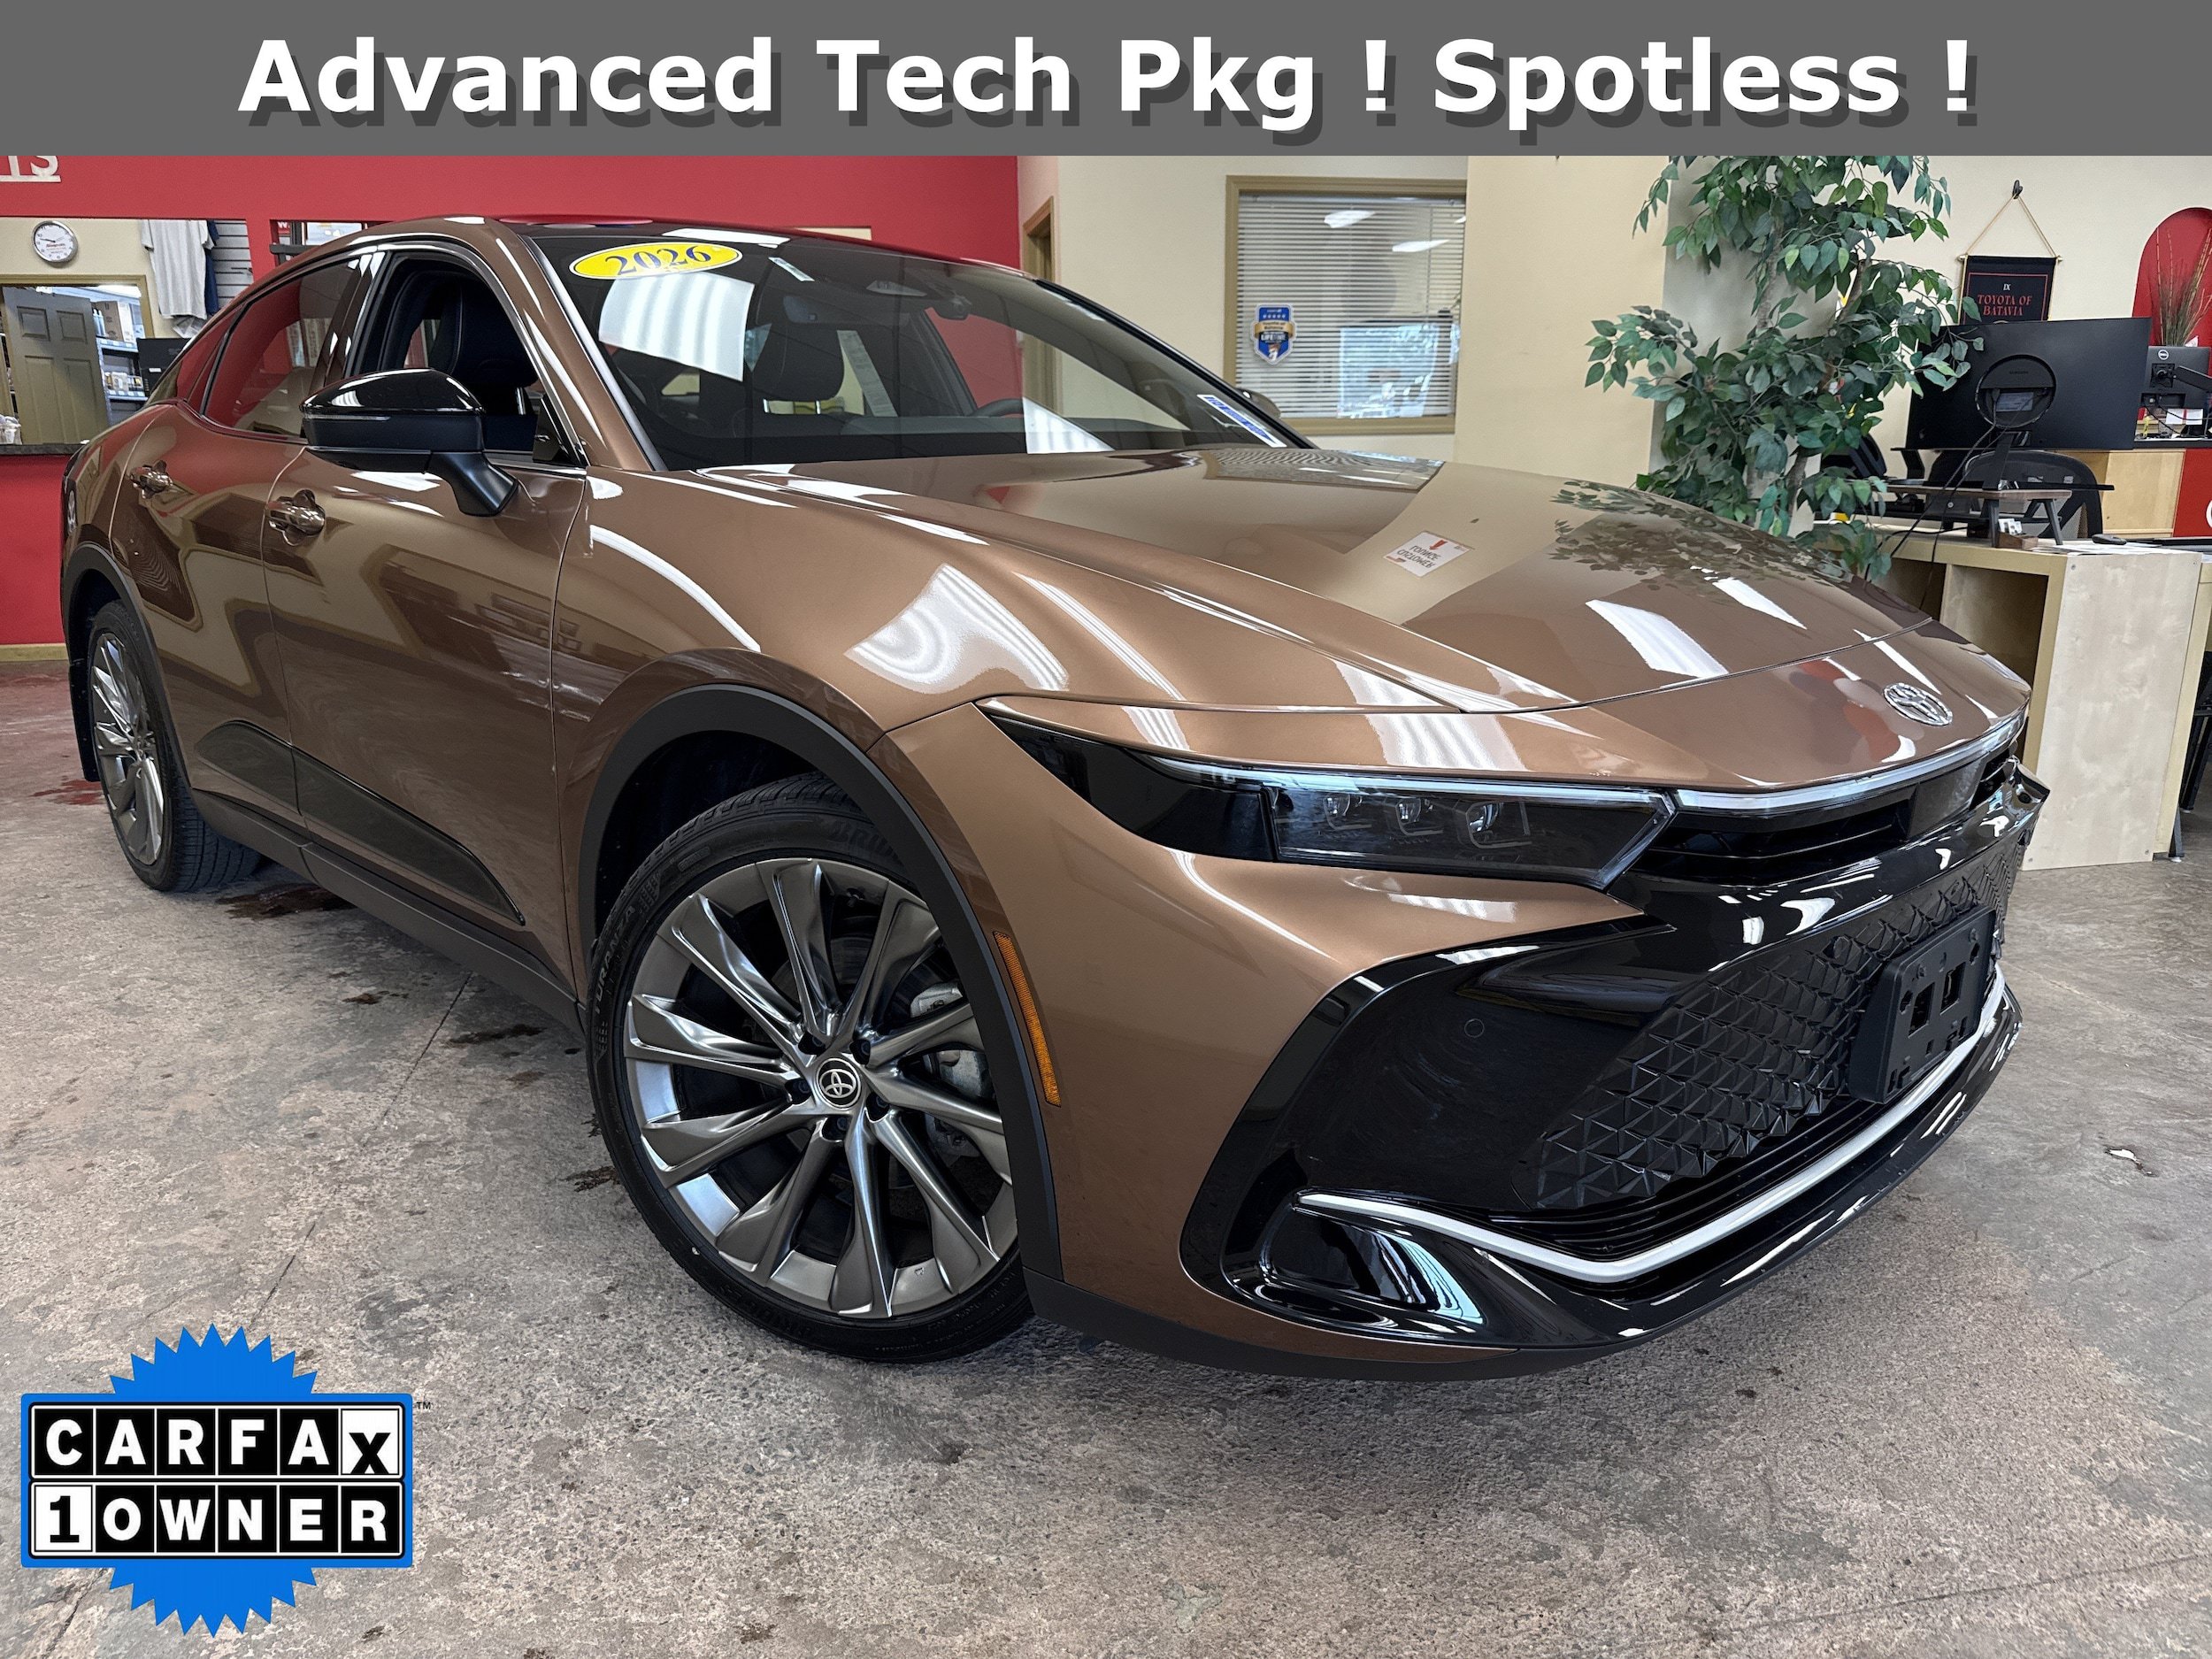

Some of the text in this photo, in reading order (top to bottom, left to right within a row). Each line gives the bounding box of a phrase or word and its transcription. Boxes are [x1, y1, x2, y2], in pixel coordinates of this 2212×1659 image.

[605, 246, 711, 275] 2026
[1978, 295, 2032, 305] TOYOTA OF
[1984, 305, 2023, 316] BATAVIA
[594, 904, 637, 1016] TURANZA
